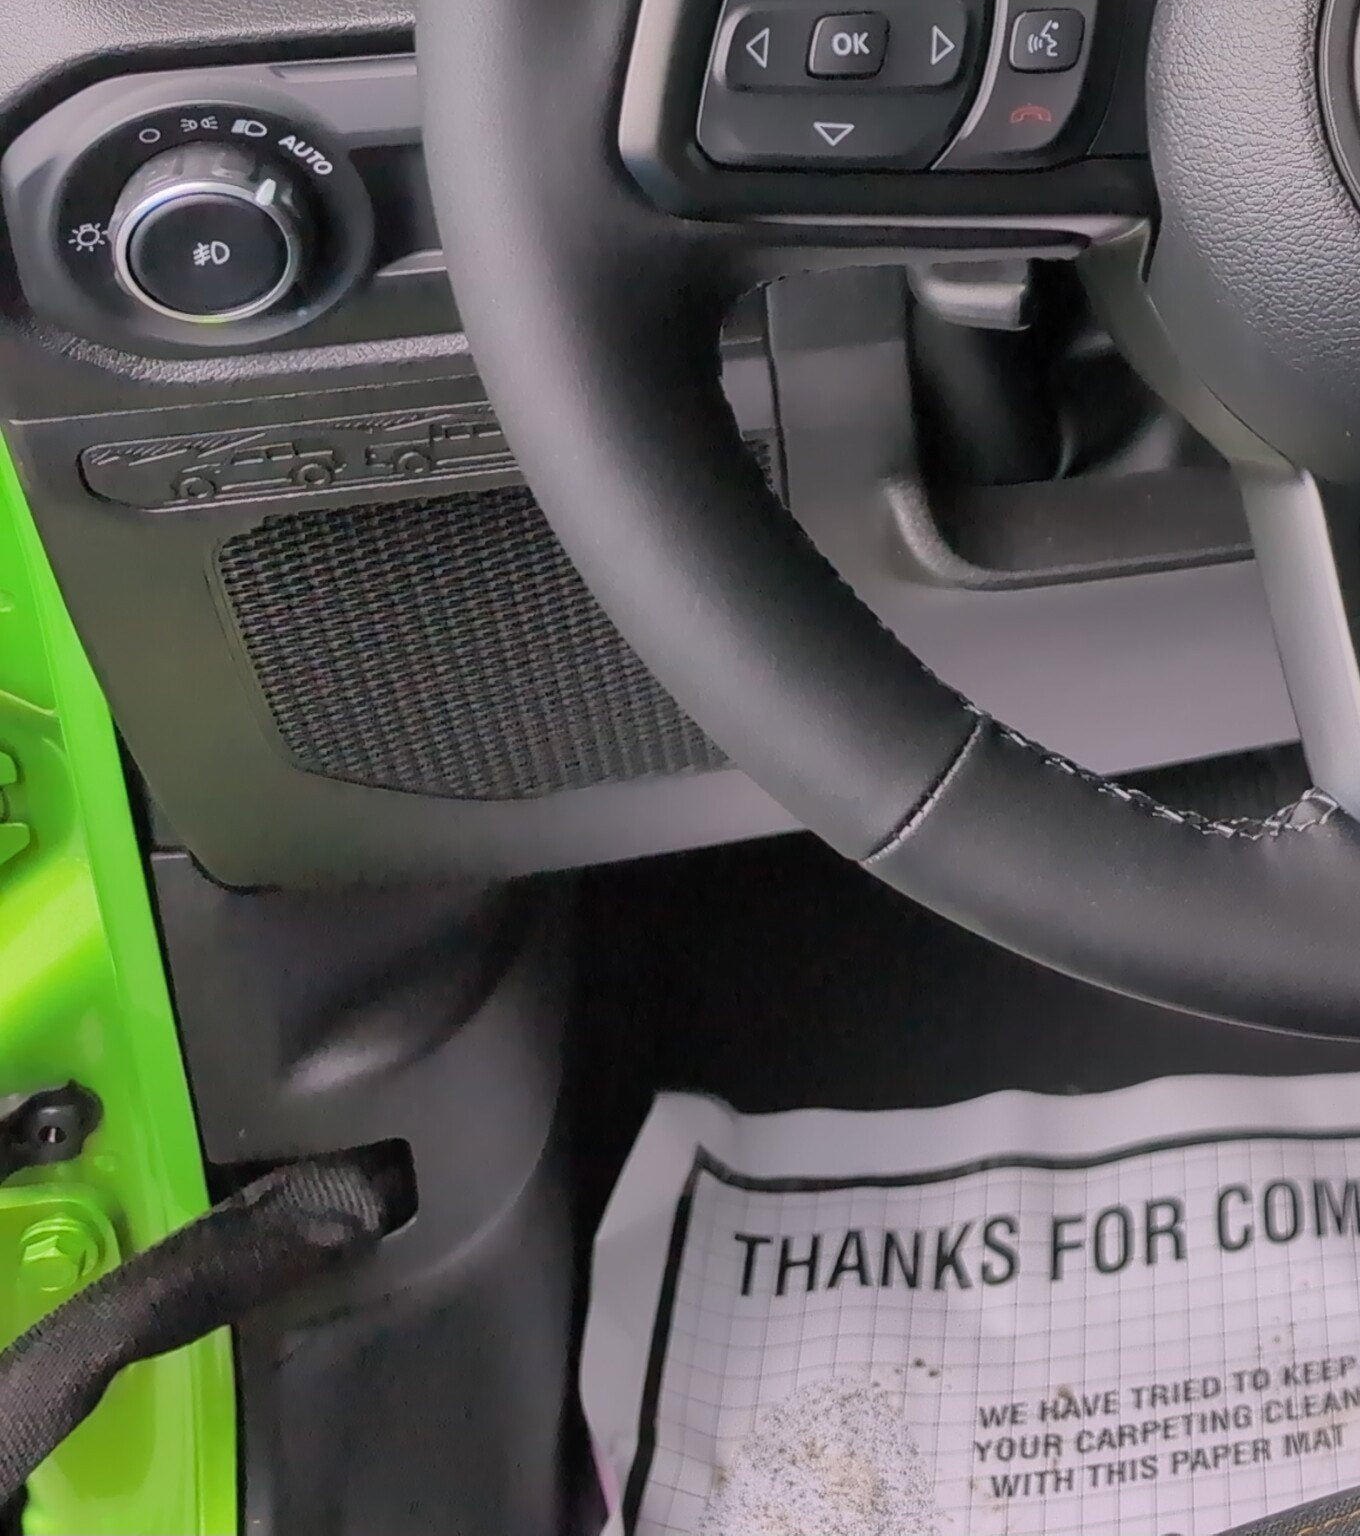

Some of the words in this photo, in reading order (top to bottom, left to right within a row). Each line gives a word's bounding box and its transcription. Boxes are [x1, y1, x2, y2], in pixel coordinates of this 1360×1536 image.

[831, 31, 872, 57] OK
[278, 134, 334, 176] AUTO
[733, 1212, 1021, 1297] THANKS
[1048, 1194, 1189, 1283] FOR
[978, 1401, 1029, 1431] WE
[1039, 1388, 1121, 1424] HAVE
[1130, 1375, 1223, 1412] TRIED
[1231, 1367, 1271, 1393] TO
[1281, 1354, 1358, 1387] KEEP
[972, 1432, 1064, 1464] YOUR
[1074, 1402, 1253, 1456] CARPETING
[990, 1464, 1076, 1500] WITH
[1087, 1454, 1160, 1489] THIS
[1169, 1435, 1272, 1476] PAPER
[1282, 1422, 1348, 1459] MAT
